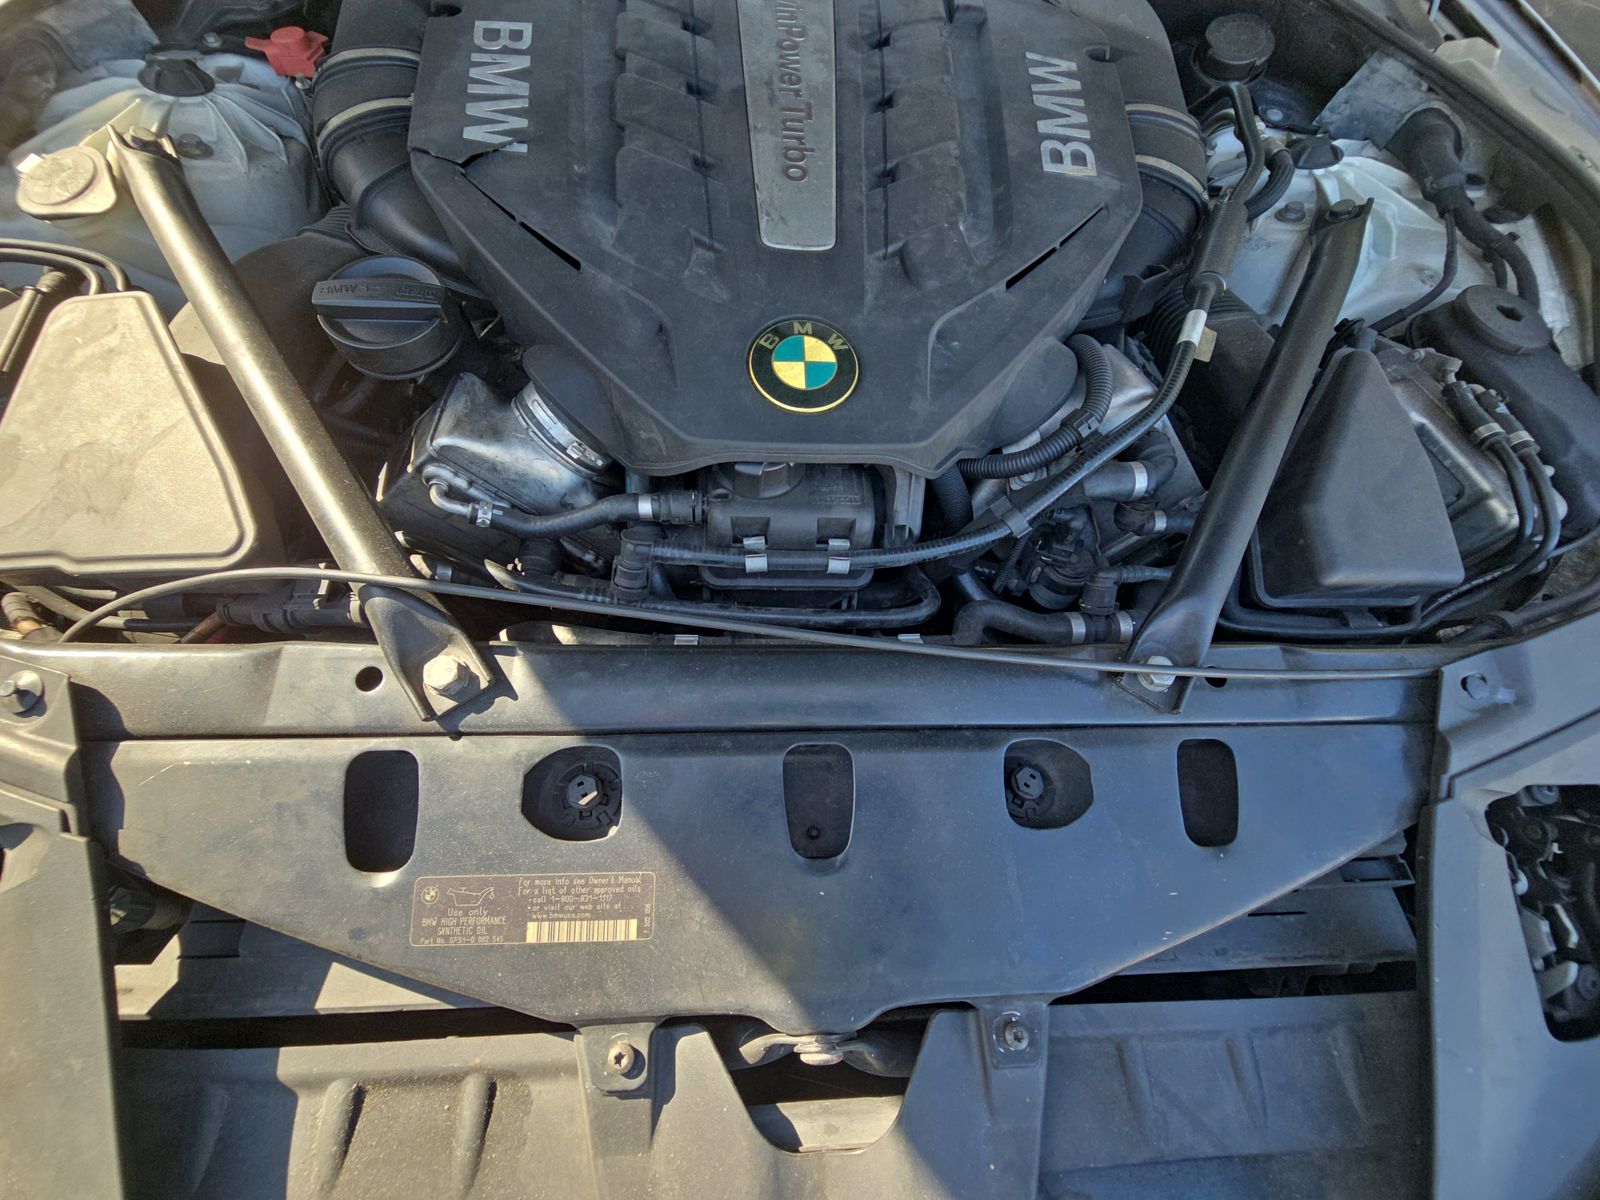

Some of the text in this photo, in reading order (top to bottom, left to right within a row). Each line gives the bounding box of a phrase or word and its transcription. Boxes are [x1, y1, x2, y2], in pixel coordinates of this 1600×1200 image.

[463, 20, 533, 154] BMW
[1025, 51, 1097, 177] BMW
[782, 101, 820, 183] Turbo
[759, 320, 850, 352] BMW
[559, 886, 567, 894] of
[571, 885, 588, 893] other
[593, 884, 624, 894] approved
[614, 902, 622, 910] at
[448, 907, 488, 917] Use only
[422, 915, 506, 926] BMW HIGH PERFORMANCE
[437, 925, 488, 936] SYNTHETIC OIL
